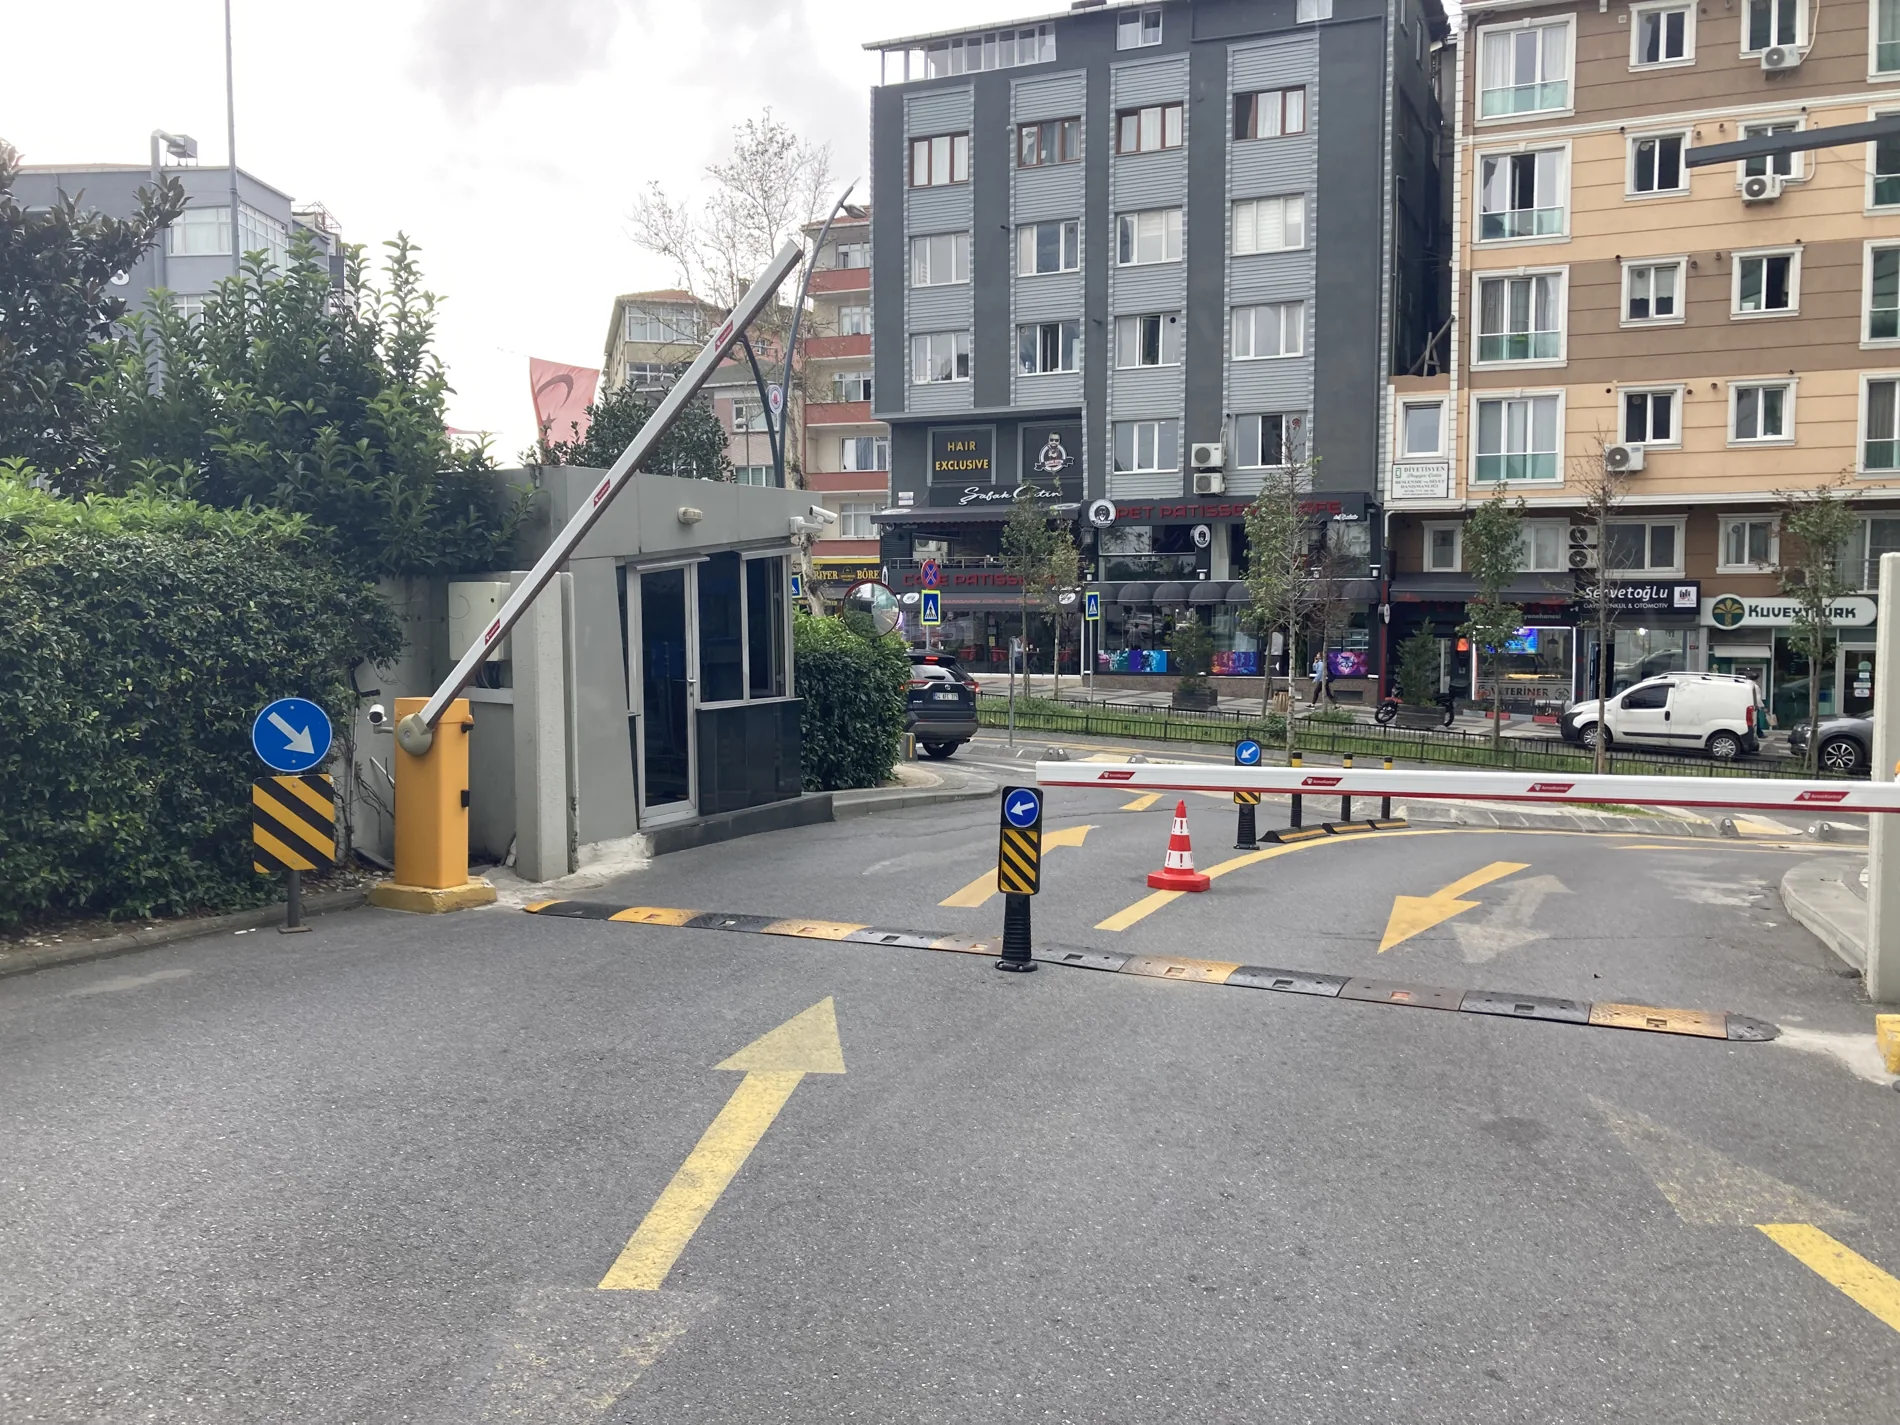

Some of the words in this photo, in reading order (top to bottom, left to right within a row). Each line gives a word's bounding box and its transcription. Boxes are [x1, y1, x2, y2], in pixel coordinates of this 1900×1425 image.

[947, 441, 976, 451] HAIR
[935, 459, 989, 471] EXCLUSIVE
[1116, 506, 1155, 519] PET
